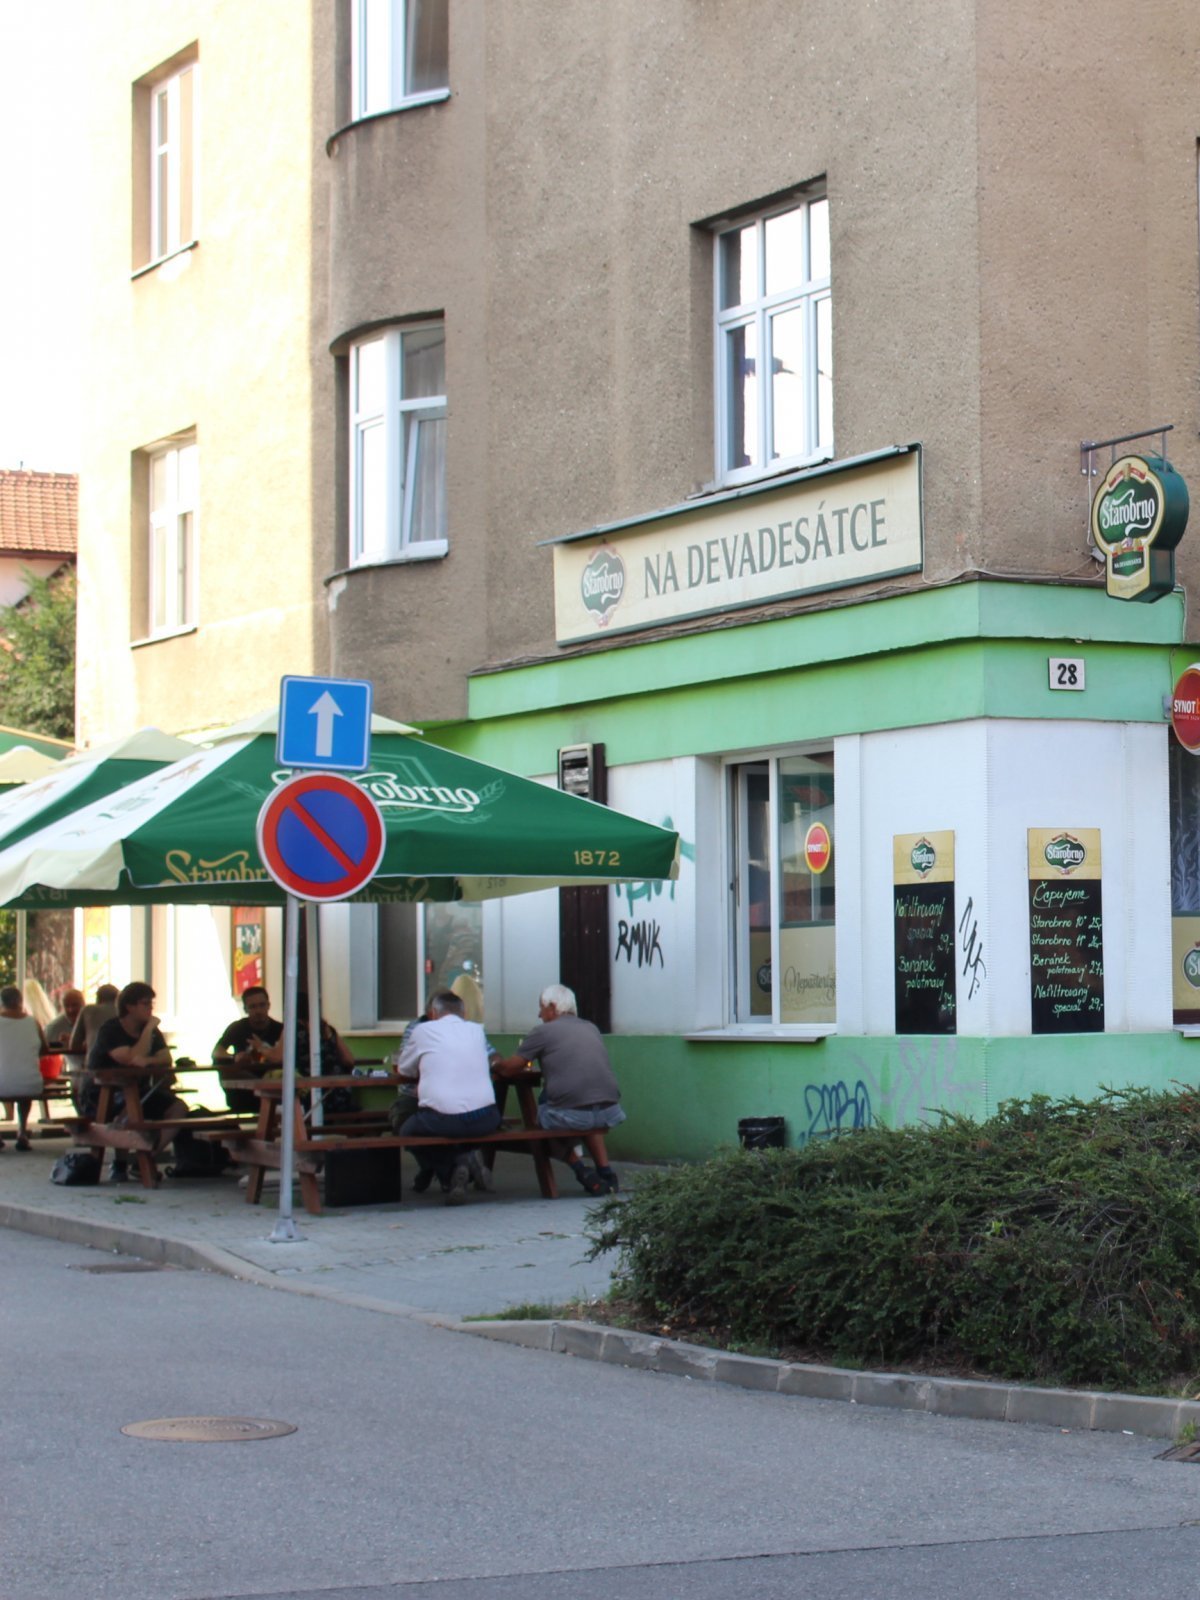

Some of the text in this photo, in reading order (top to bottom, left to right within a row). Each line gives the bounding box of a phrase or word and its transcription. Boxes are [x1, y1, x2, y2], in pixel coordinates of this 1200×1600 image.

[1101, 489, 1155, 536] Starobrno
[644, 498, 888, 599] NA DEVADESÁTCE
[583, 563, 624, 604] Starobrno
[1057, 663, 1078, 685] 28
[574, 850, 621, 866] 1872
[1047, 843, 1084, 865] Starobrno
